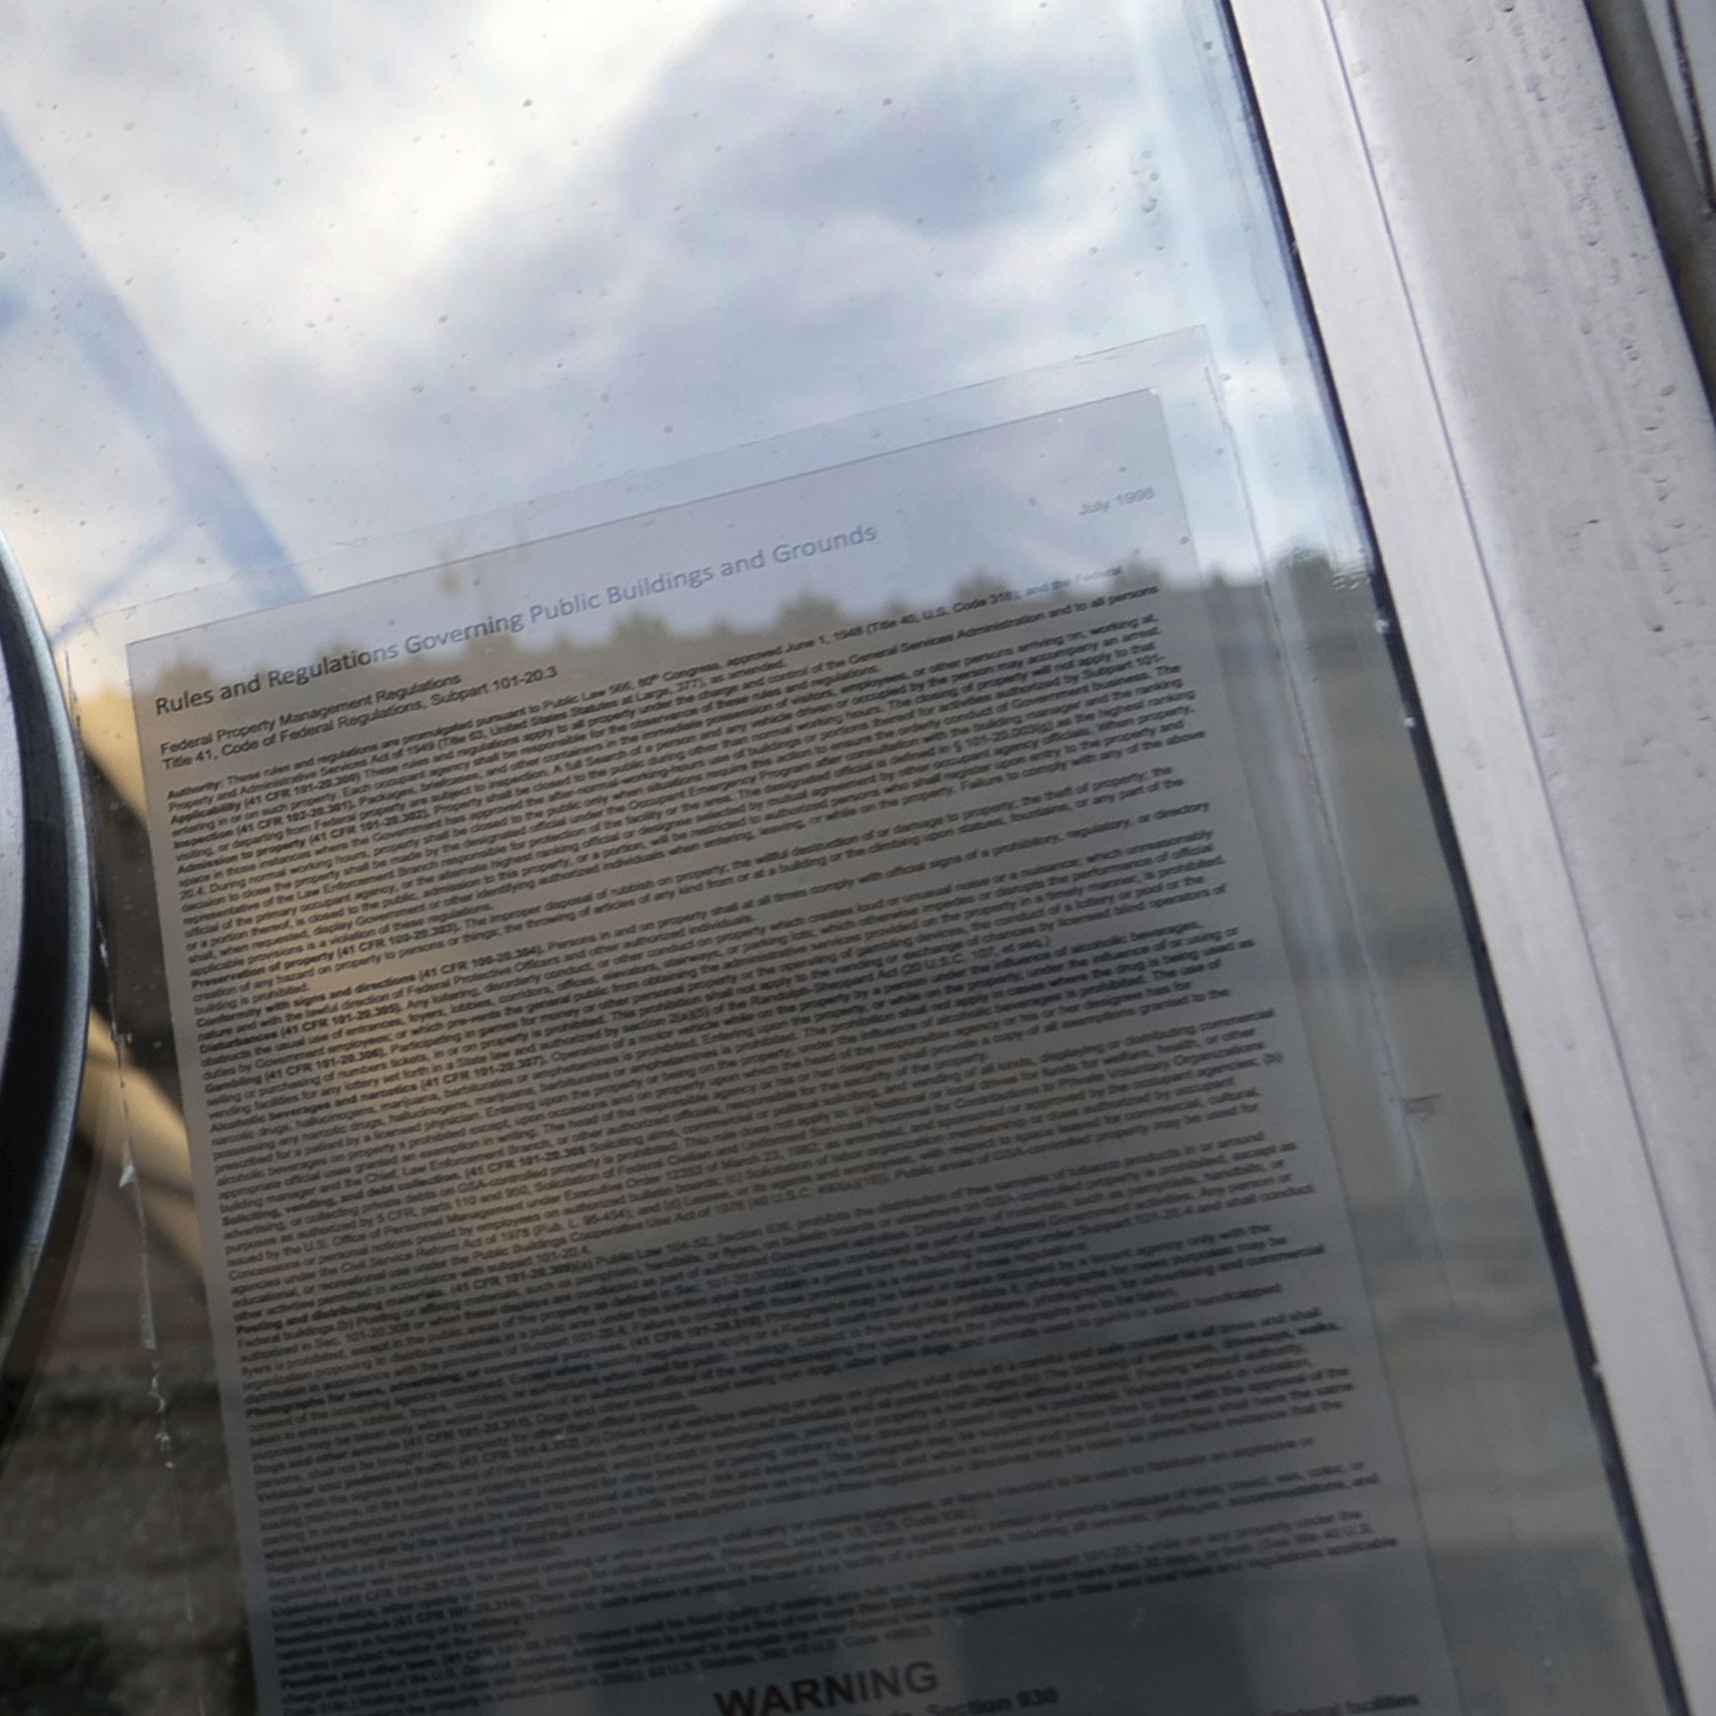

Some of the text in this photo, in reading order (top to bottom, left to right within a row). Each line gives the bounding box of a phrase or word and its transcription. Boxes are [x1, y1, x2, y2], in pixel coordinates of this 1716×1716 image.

[153, 522, 879, 716] Rules and Regulations Governing Public Buildings and Grounds
[158, 672, 463, 755] Federal Property Management Regulations
[162, 664, 559, 771] Title 41, Code of Federal Regulations, Subpart 101-20.3
[1014, 1684, 1060, 1709] 930
